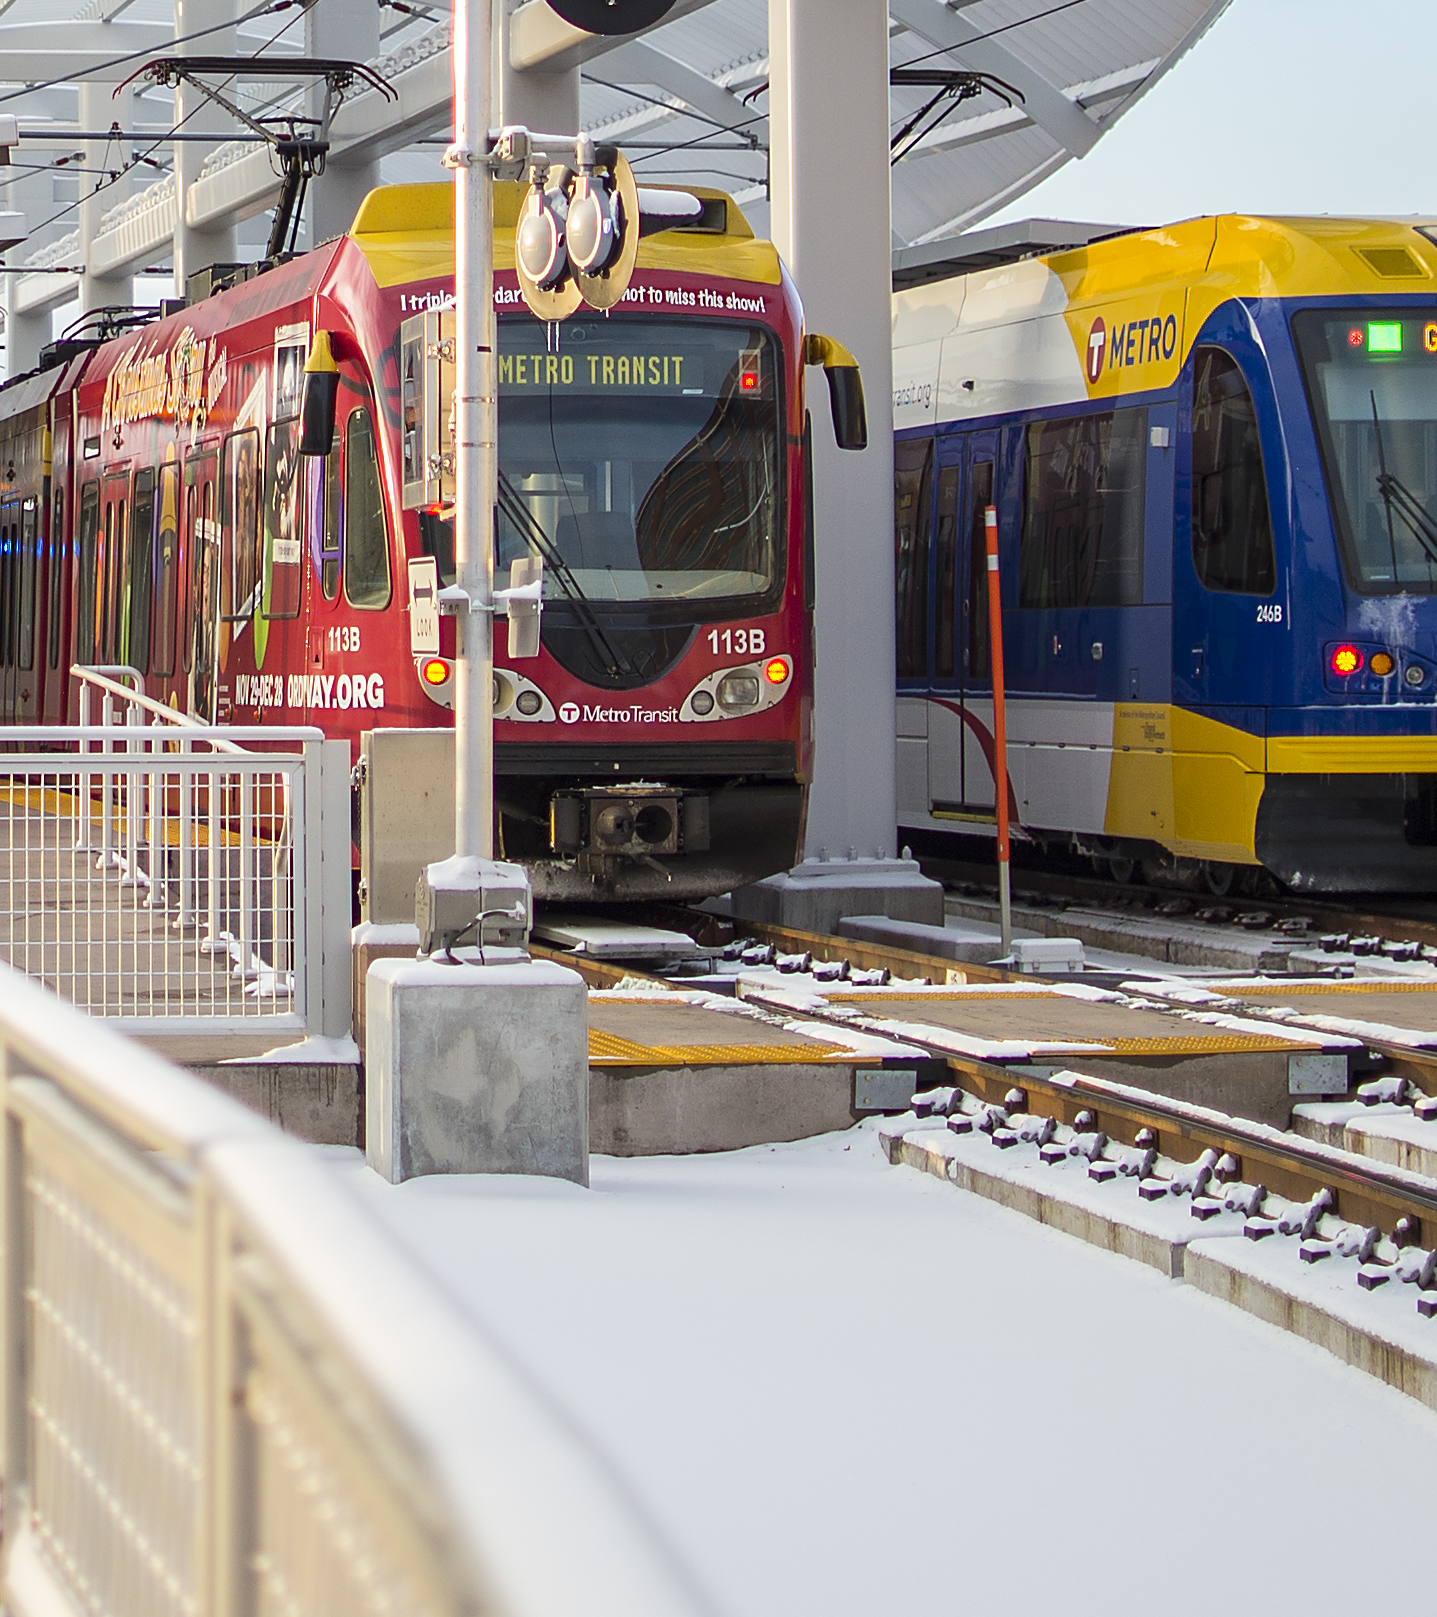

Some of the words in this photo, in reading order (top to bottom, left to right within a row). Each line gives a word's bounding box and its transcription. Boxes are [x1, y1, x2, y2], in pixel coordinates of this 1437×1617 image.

[646, 285, 663, 304] to
[665, 287, 696, 306] miss
[697, 288, 724, 309] this
[726, 291, 766, 314] show!
[1109, 314, 1177, 370] METRO
[498, 355, 574, 385] METRO
[586, 355, 684, 385] TRANSIT
[415, 617, 432, 637] LOOK
[1256, 604, 1283, 623] 246B
[328, 626, 361, 652] 113B
[707, 628, 766, 655] 113B
[287, 672, 385, 710] ORDWAY.ORG
